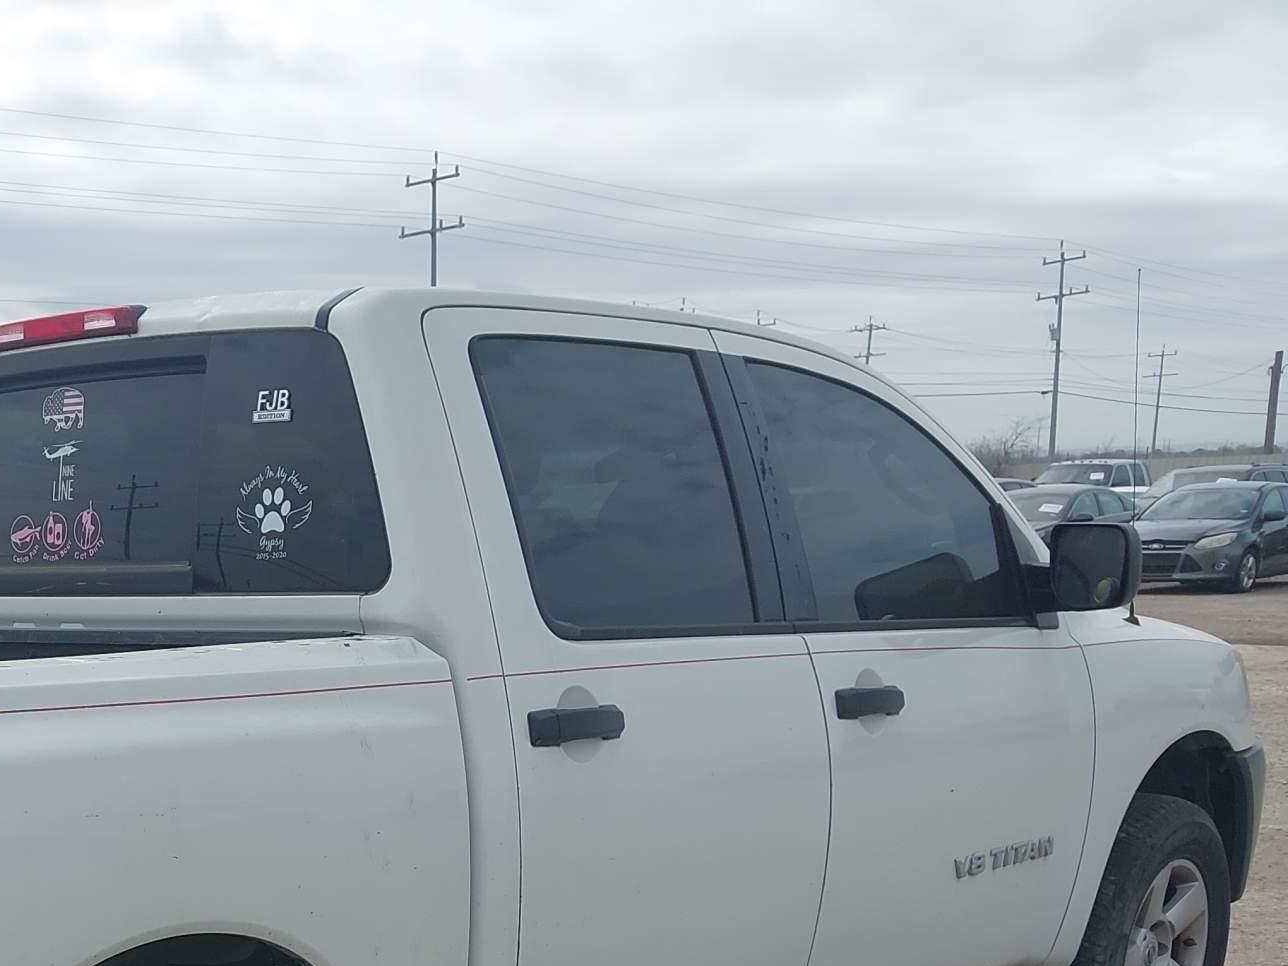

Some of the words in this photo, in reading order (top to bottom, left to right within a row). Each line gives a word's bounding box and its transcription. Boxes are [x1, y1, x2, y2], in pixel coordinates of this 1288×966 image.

[257, 389, 289, 411] FJB
[62, 464, 75, 477] NINE
[52, 479, 75, 501] LINE
[240, 473, 264, 501] Always
[274, 465, 287, 485] My
[287, 469, 309, 495] Heart
[42, 552, 59, 562] Drink
[59, 540, 73, 558] Beer
[259, 535, 284, 552] Gypsy
[74, 551, 88, 560] Get
[954, 852, 987, 880] V8
[989, 834, 1054, 871] TITAN
